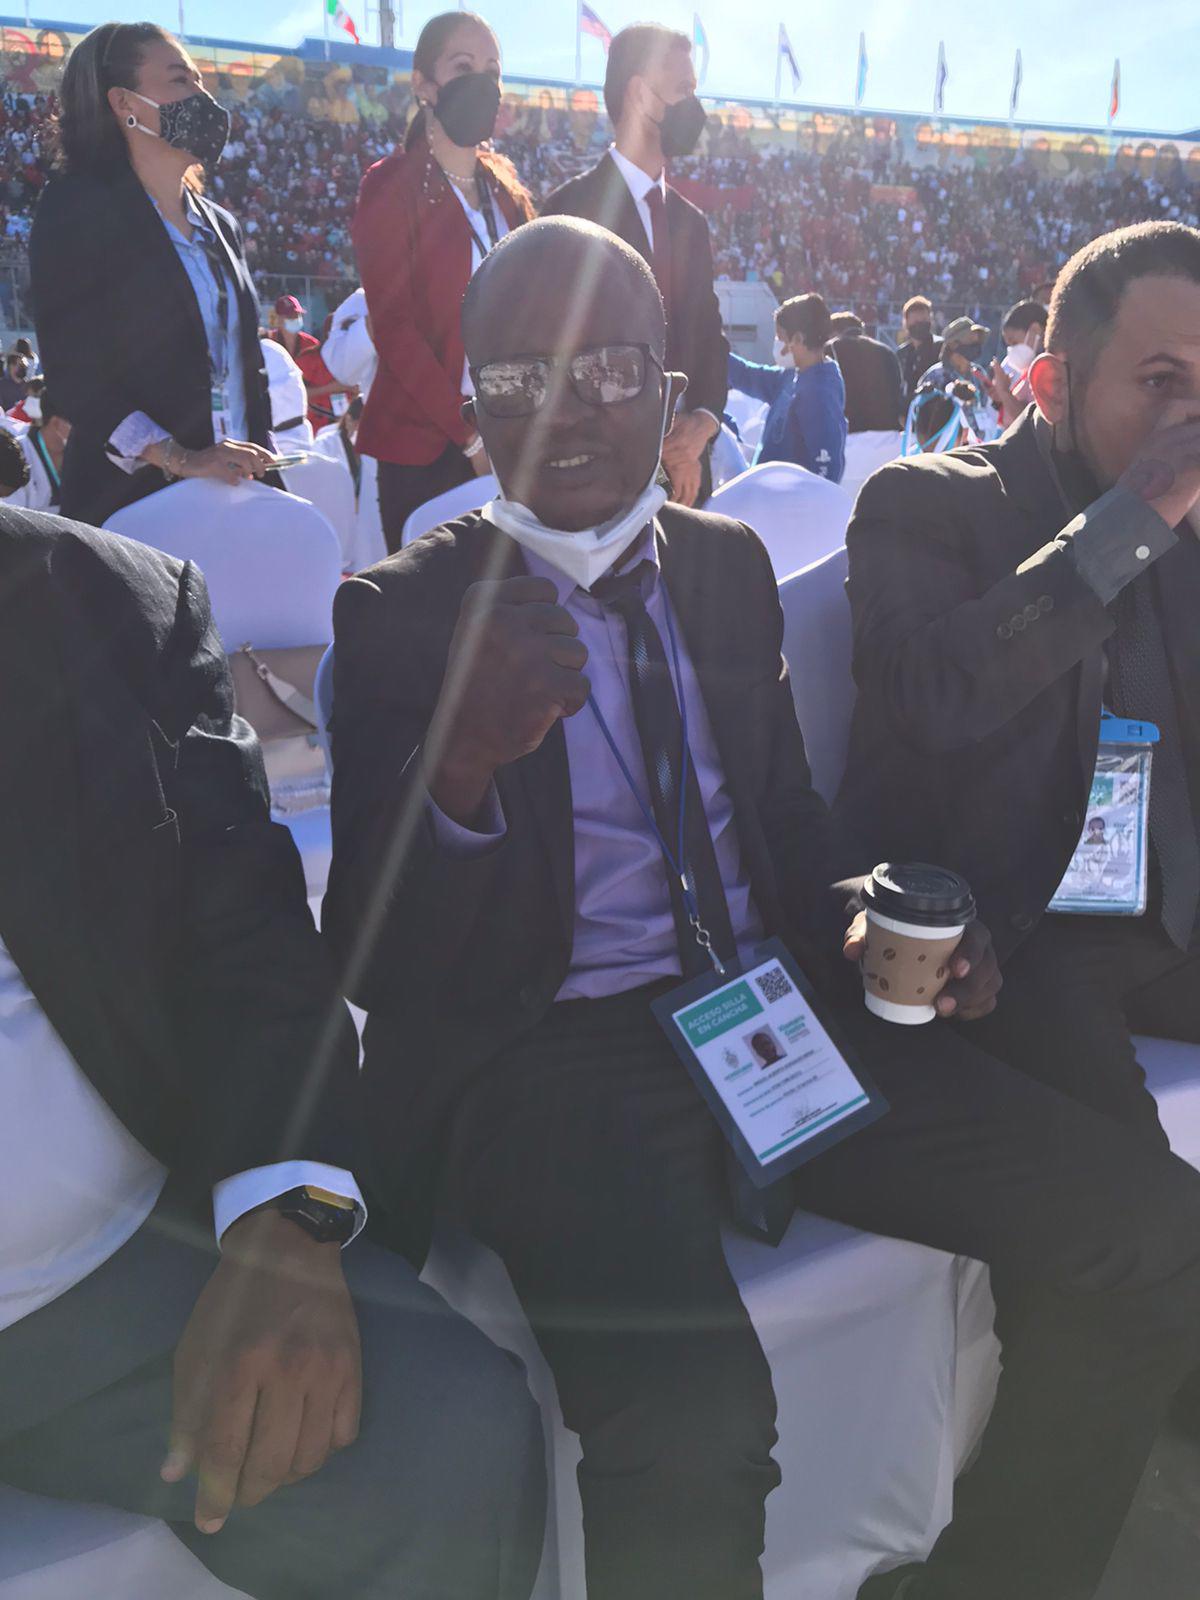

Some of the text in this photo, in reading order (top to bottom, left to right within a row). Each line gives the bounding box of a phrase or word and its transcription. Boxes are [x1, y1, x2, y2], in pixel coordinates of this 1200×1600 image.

[688, 993, 748, 1031] ACCESO SILLA
[696, 1002, 749, 1034] EN CANCHA
